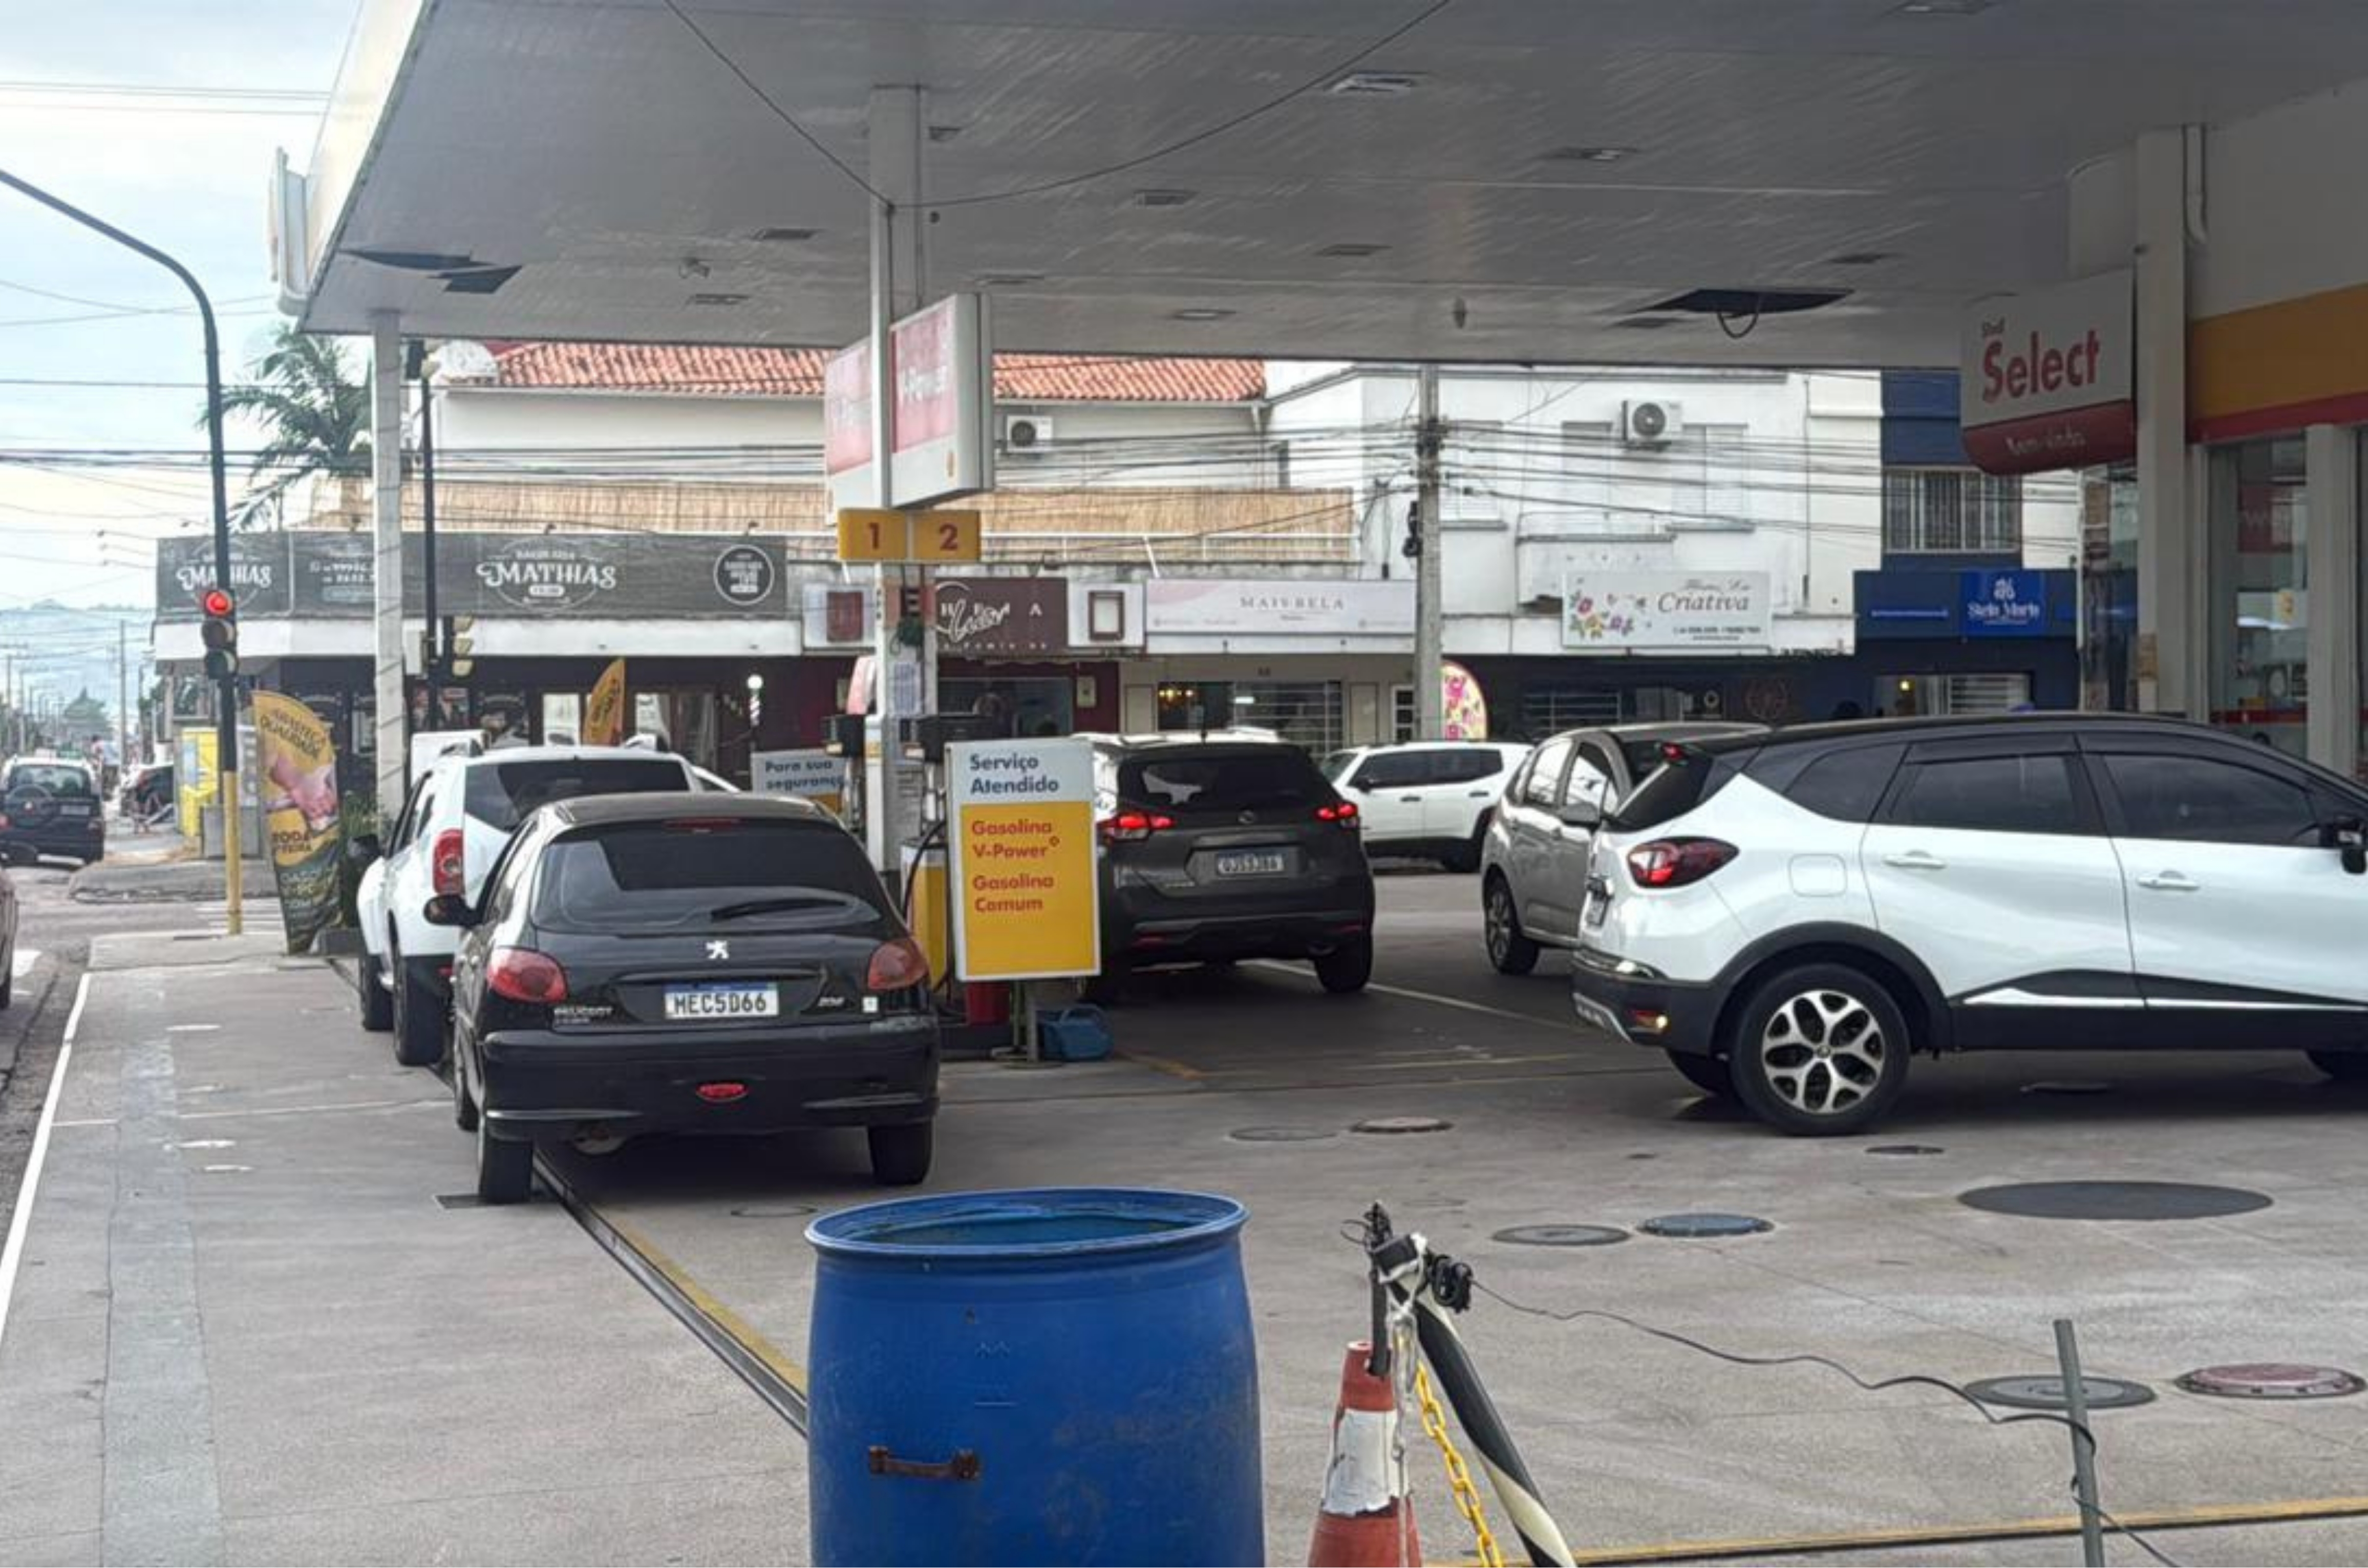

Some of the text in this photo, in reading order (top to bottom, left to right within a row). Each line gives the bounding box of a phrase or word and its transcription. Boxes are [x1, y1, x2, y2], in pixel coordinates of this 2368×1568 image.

[1982, 329, 2100, 404] Select
[868, 522, 958, 550] 1 2
[176, 564, 272, 590] MAHIAS
[476, 561, 616, 589] MATHIAS
[1658, 592, 1749, 613] Criativa
[765, 760, 801, 773] Para
[970, 753, 1039, 773] Serviço
[971, 776, 1059, 794] Atendido
[972, 819, 1052, 835] Gasolina
[973, 873, 1054, 891] Gasolina
[974, 897, 1043, 912] Comum
